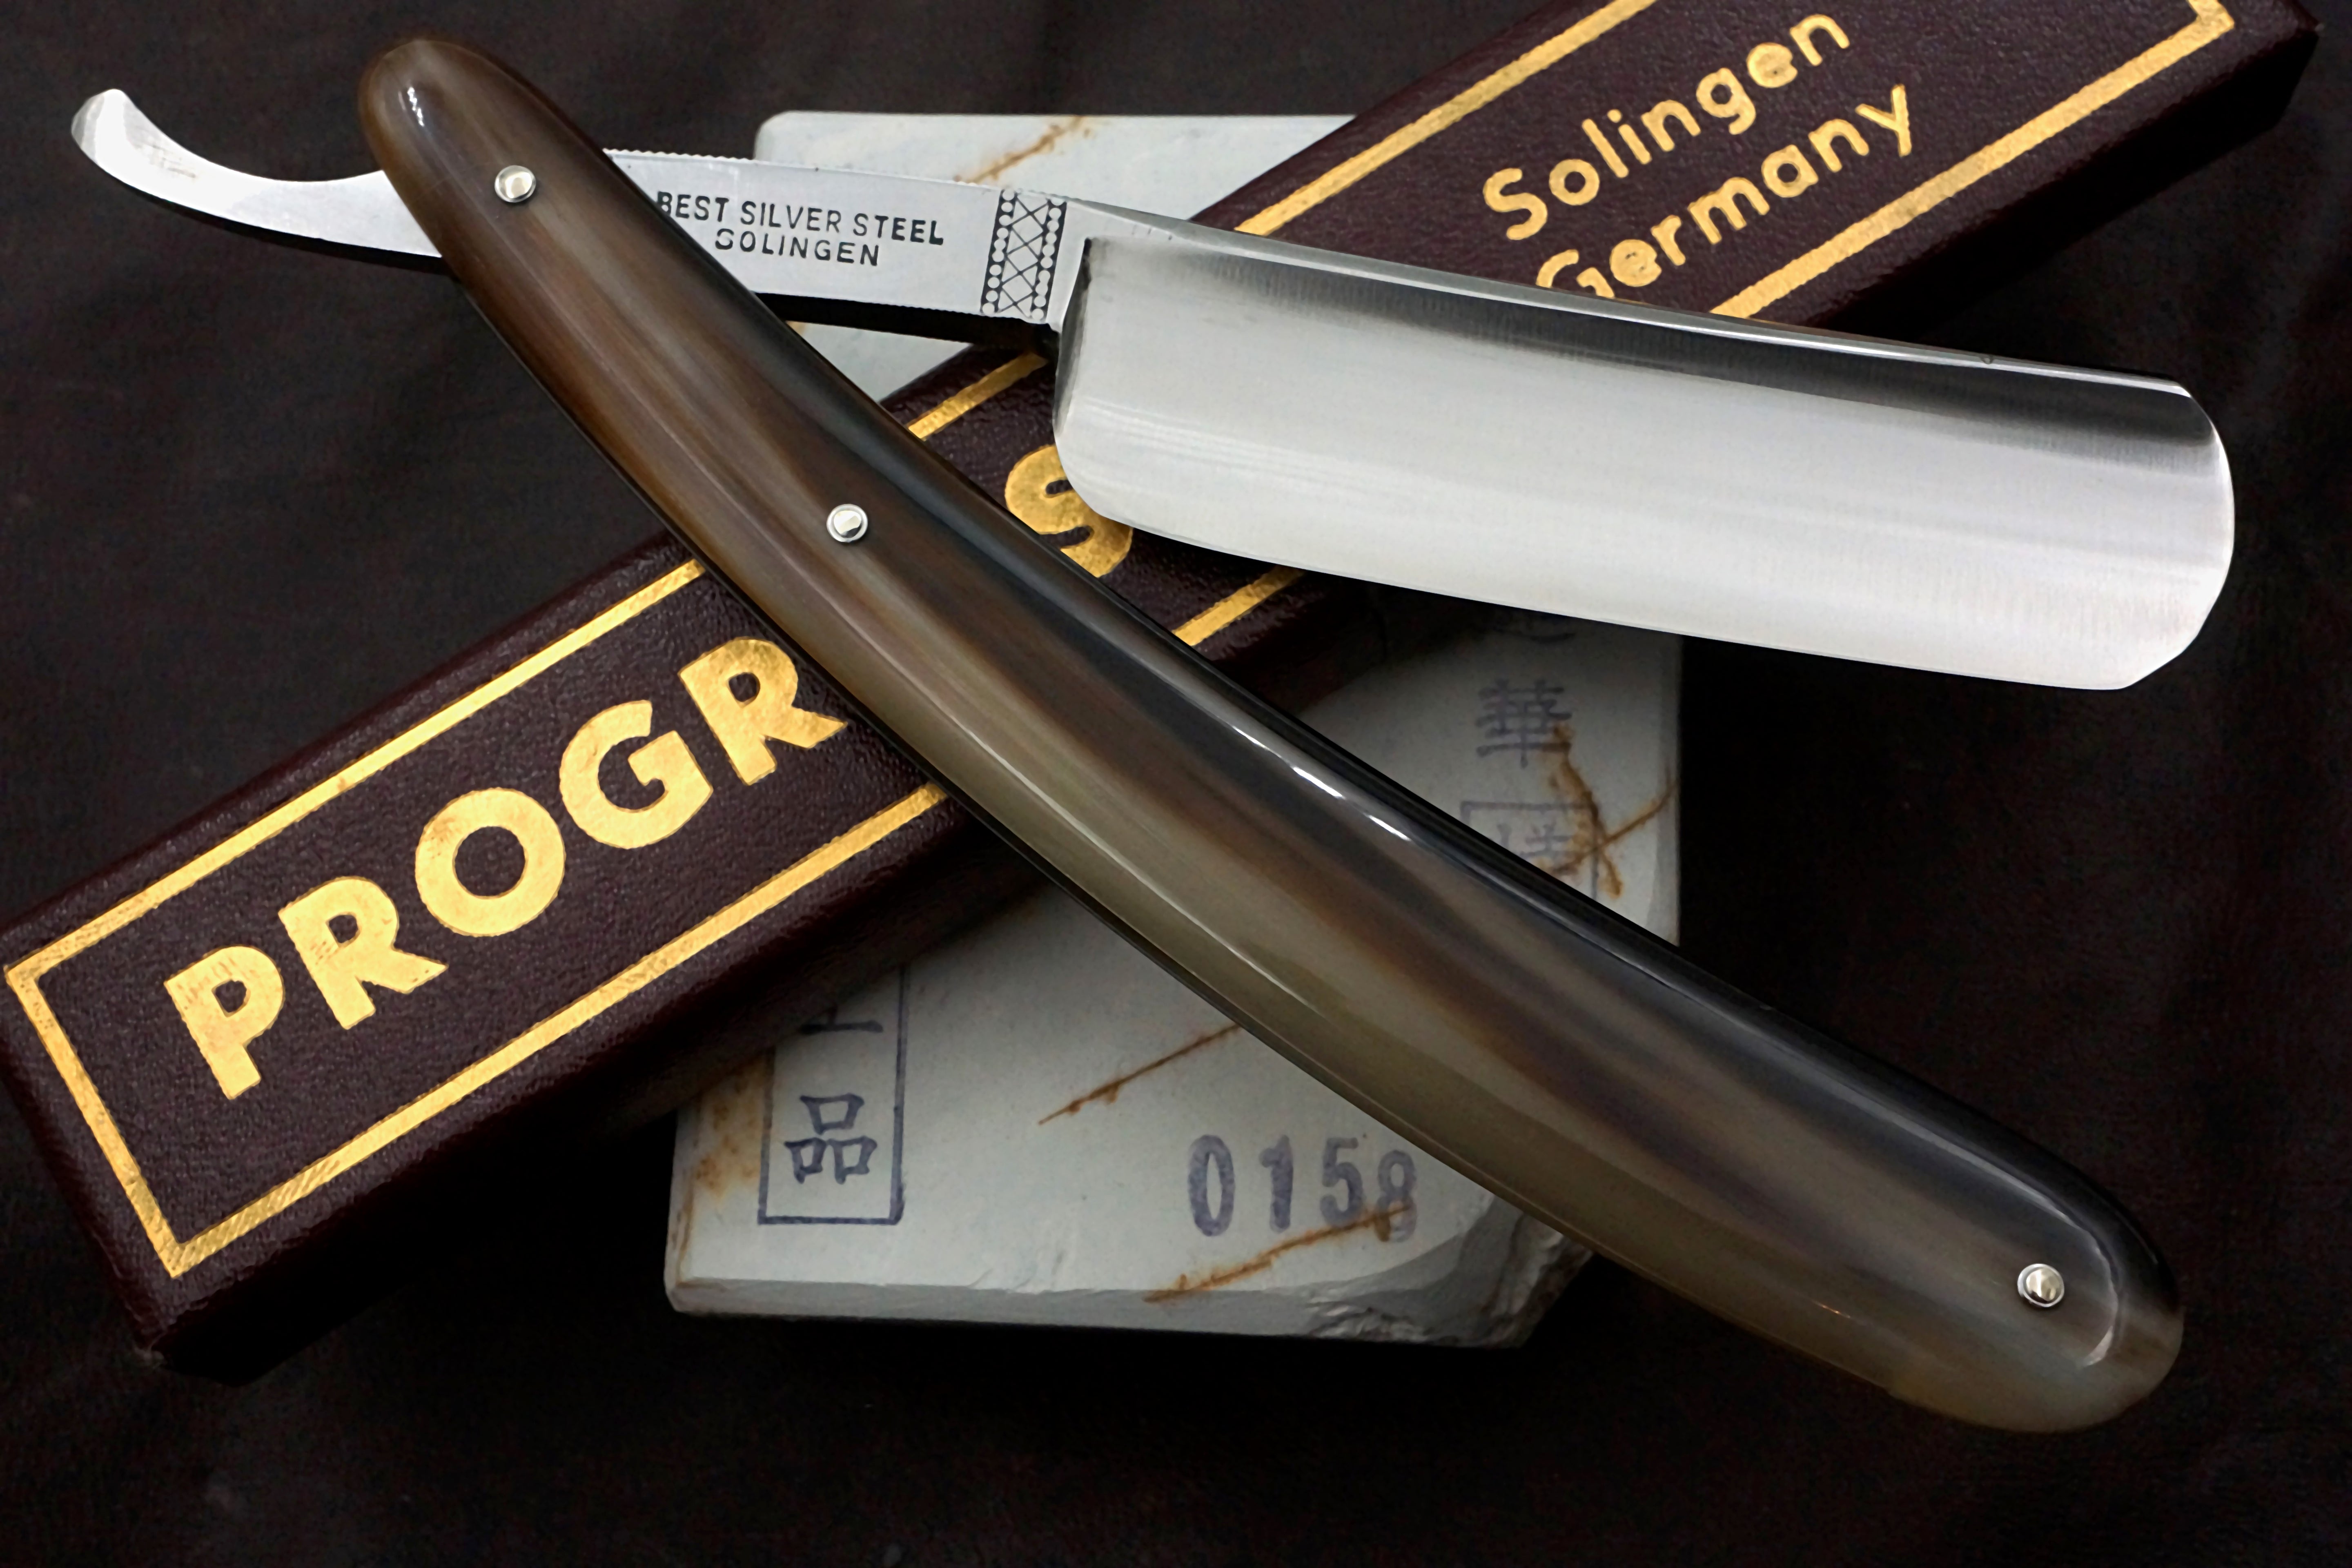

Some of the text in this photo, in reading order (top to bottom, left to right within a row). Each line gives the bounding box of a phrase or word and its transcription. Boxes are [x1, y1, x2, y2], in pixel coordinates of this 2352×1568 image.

[1483, 14, 1850, 240] Solingen
[657, 191, 944, 245] BEST SILVER STEEL
[715, 228, 879, 267] SOLINGEN
[1187, 1134, 1418, 1243] 0158
